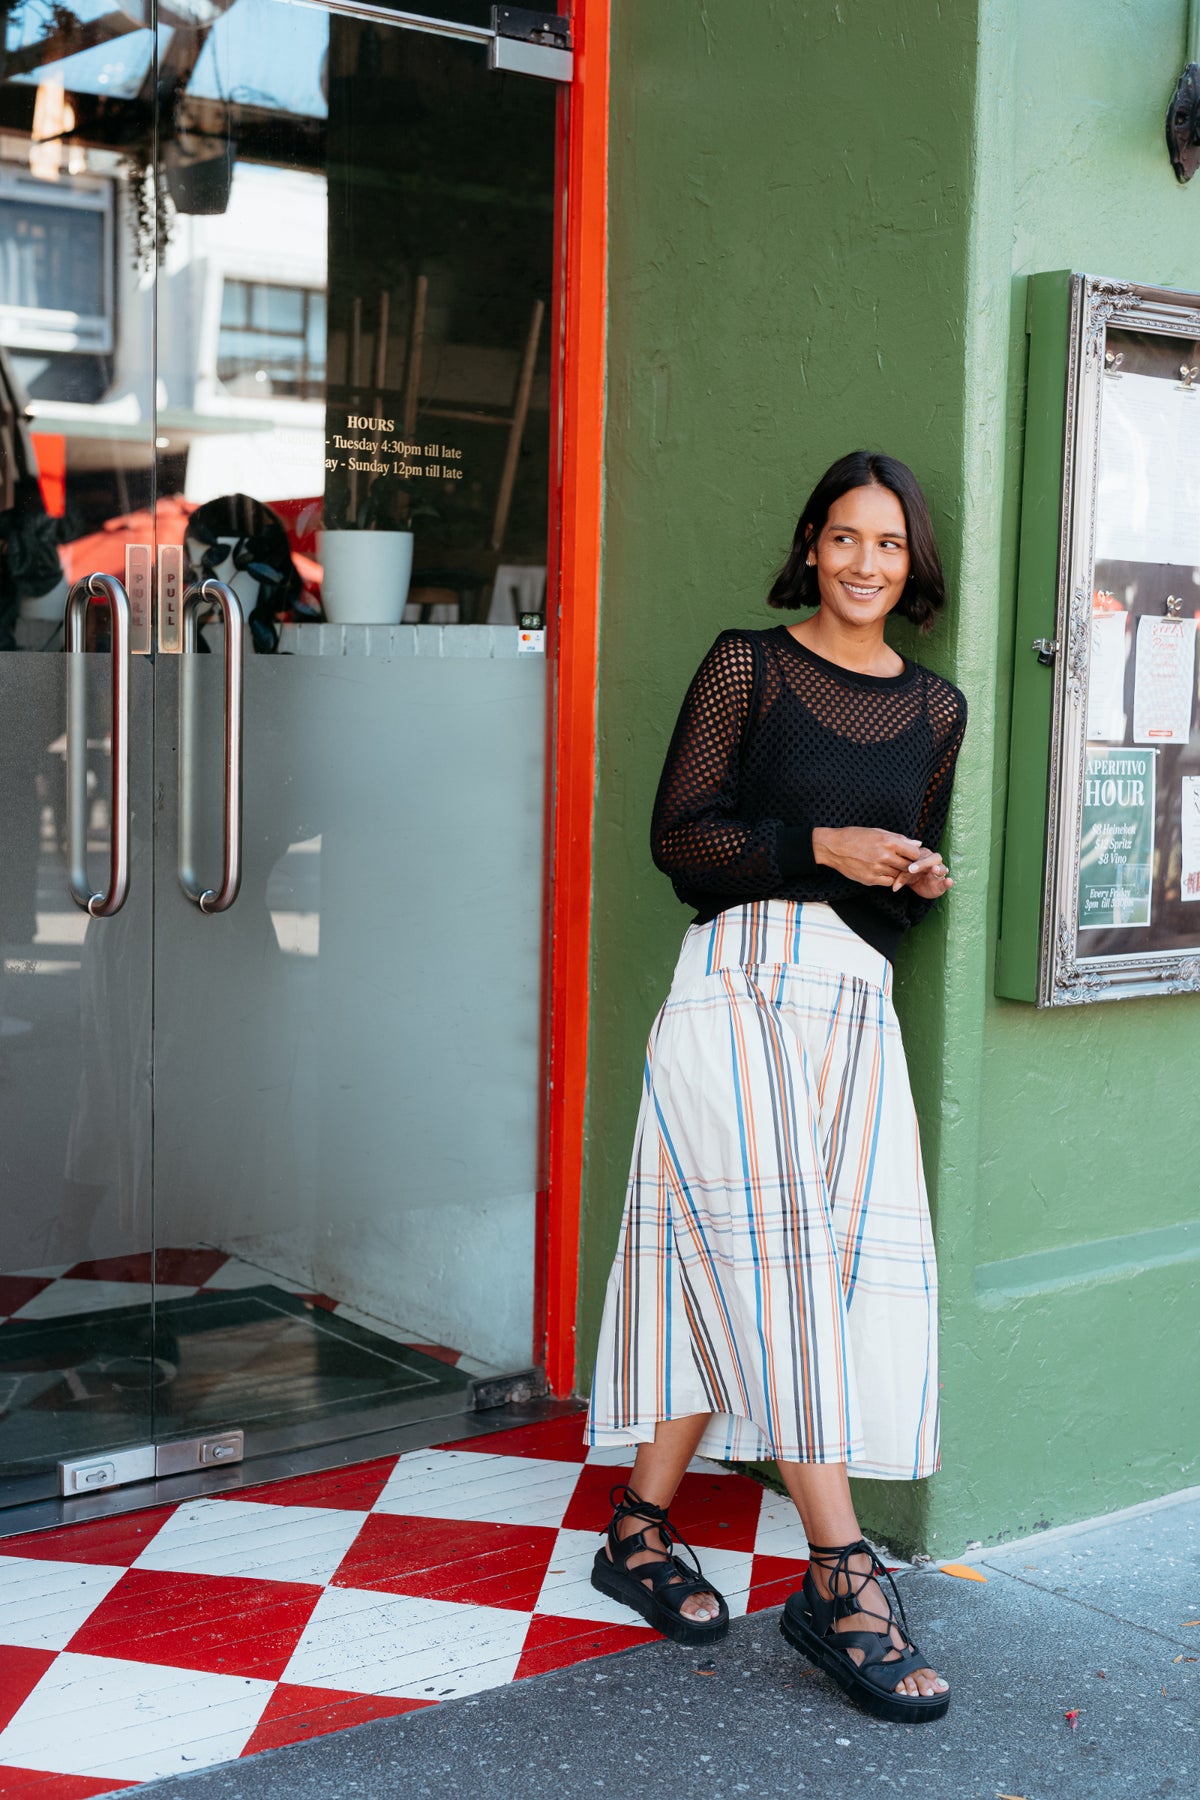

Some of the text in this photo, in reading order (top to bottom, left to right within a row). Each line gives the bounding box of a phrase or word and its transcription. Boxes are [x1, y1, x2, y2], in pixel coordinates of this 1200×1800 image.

[347, 415, 395, 432] HOURS
[333, 435, 379, 455] Tuesday
[381, 440, 421, 457] 4:30pm
[424, 444, 439, 457] till
[441, 445, 462, 459] late
[348, 457, 390, 476] Sunday
[393, 461, 422, 478] 12pm
[425, 464, 440, 477] till
[442, 465, 463, 479] late
[167, 573, 175, 626] PULL
[1085, 759, 1146, 776] APERITIVO
[1084, 779, 1145, 807] HOUR
[1109, 838, 1132, 853] Spritz
[1098, 853, 1127, 865] $8 Vino
[1089, 888, 1110, 899] Every
